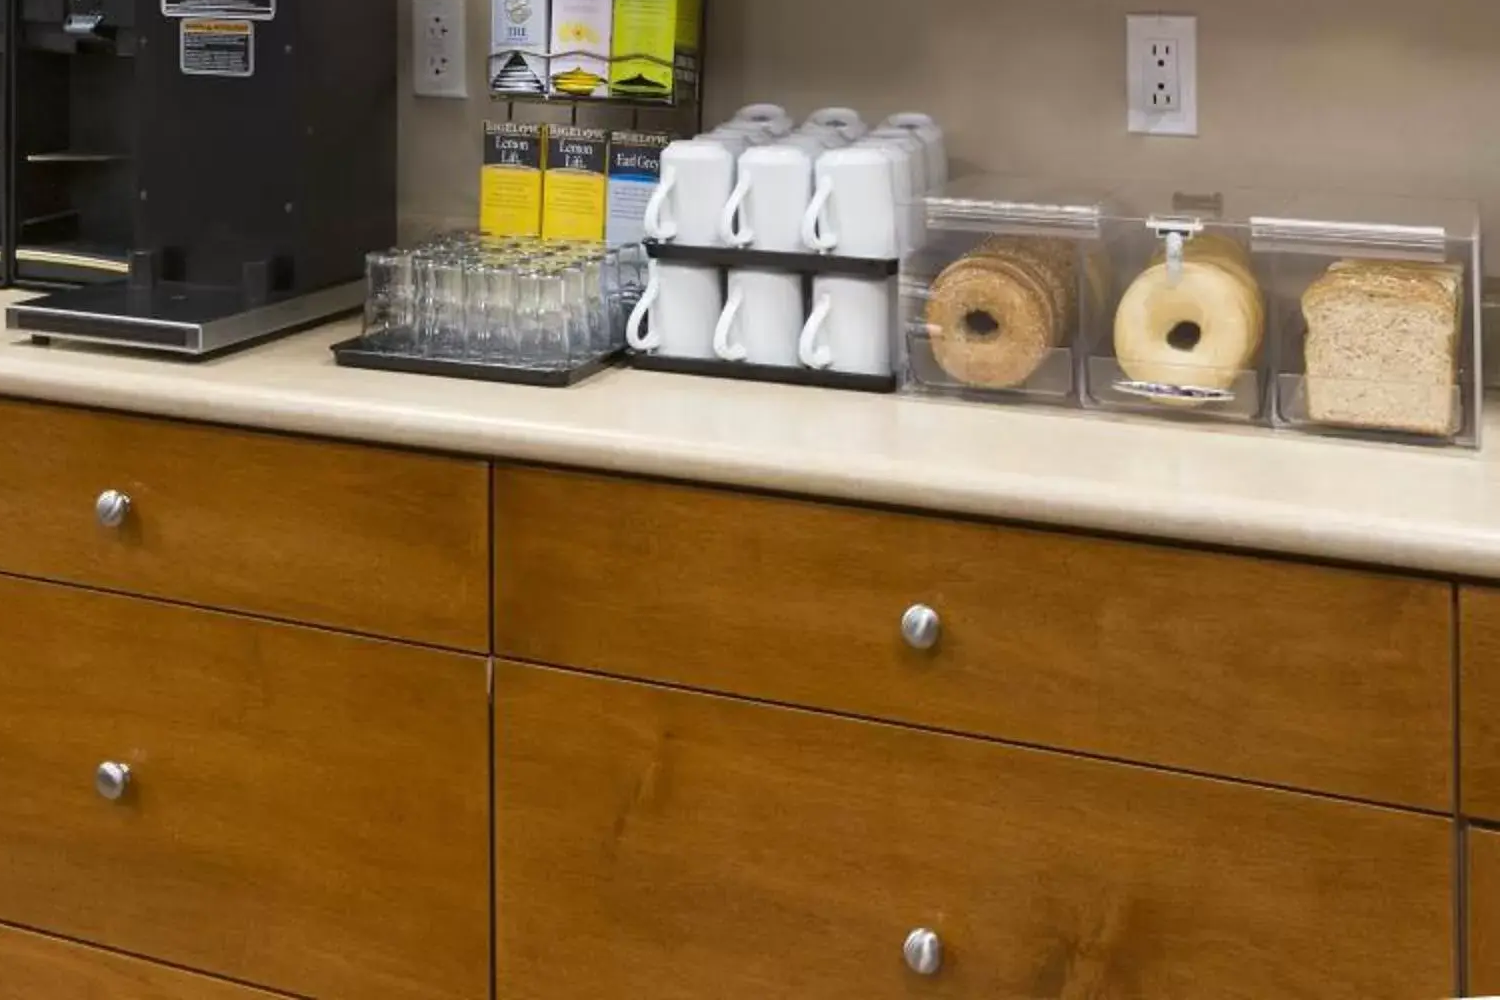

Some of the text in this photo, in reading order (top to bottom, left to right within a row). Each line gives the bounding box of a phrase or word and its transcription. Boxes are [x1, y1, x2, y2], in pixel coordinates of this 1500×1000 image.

[495, 135, 529, 151] Lemon
[558, 139, 594, 155] Lemon
[616, 153, 637, 168] Earl
